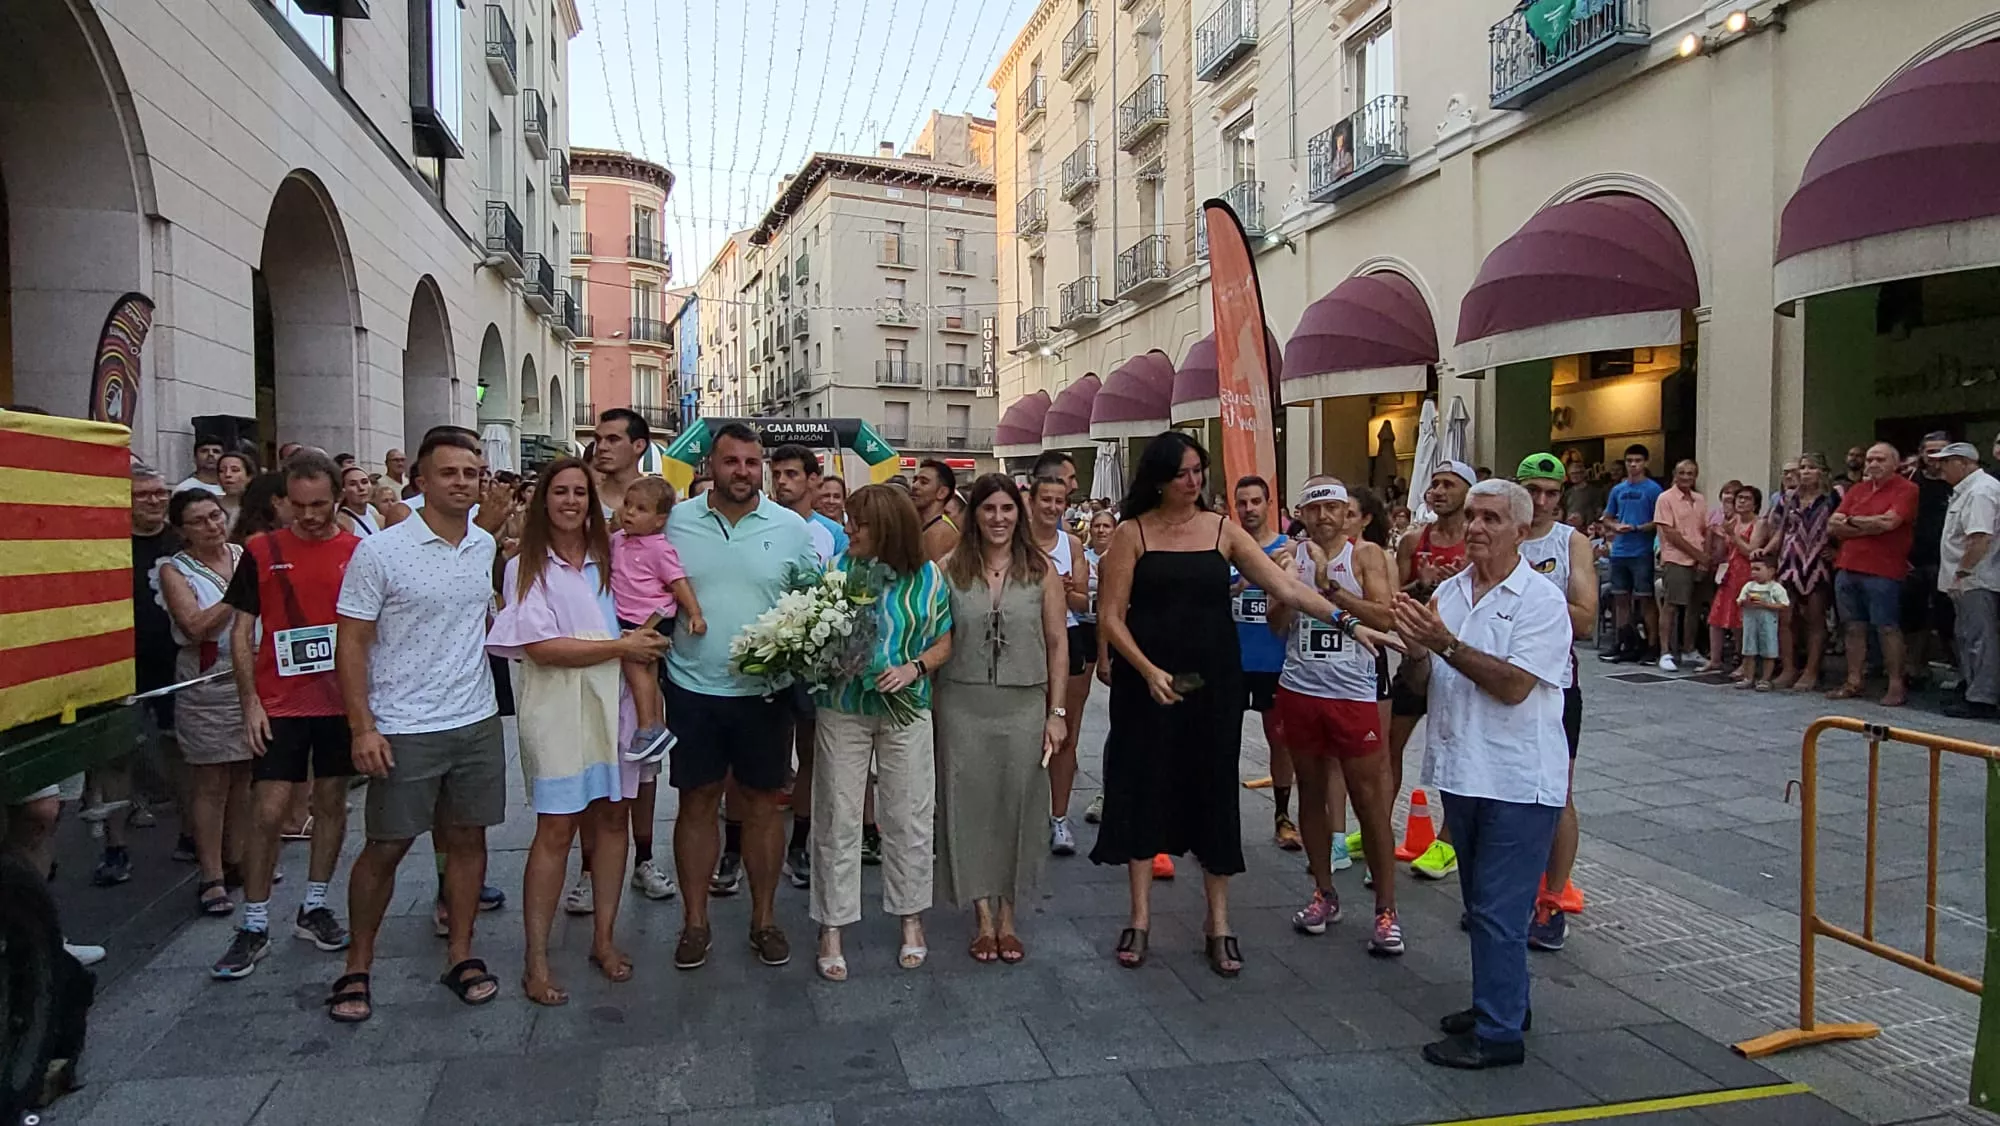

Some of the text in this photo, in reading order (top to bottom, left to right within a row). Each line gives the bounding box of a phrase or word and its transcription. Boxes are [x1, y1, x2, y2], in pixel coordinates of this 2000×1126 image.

[983, 318, 993, 384] HOSTAL
[766, 423, 831, 433] CAJA RURAL
[788, 433, 823, 441] ARAGÓN
[1250, 601, 1266, 613] 56
[1320, 633, 1339, 649] 61
[305, 641, 330, 659] 60
